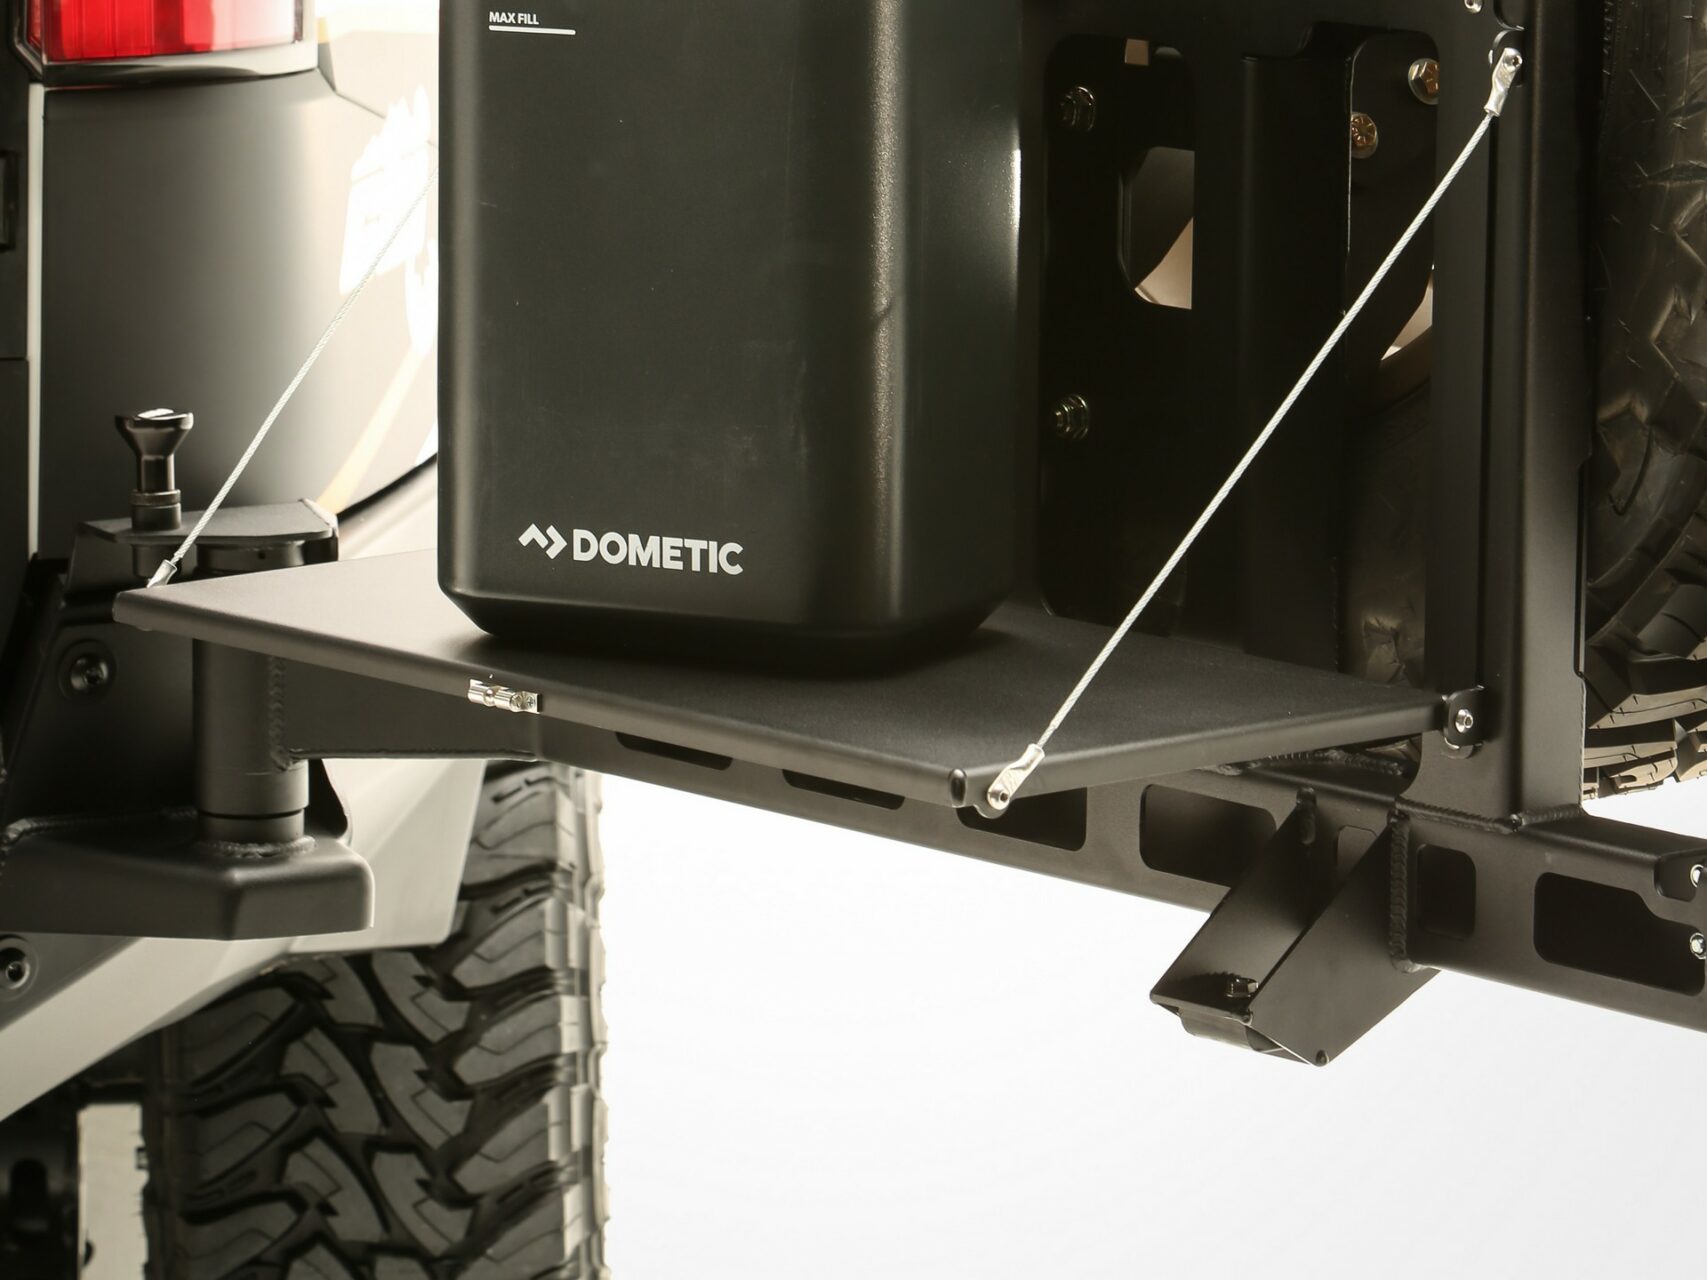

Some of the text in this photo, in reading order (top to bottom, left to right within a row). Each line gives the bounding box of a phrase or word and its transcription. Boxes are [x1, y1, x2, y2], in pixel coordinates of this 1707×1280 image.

[489, 11, 540, 25] MAX FILL
[573, 528, 744, 575] DOMETIC
